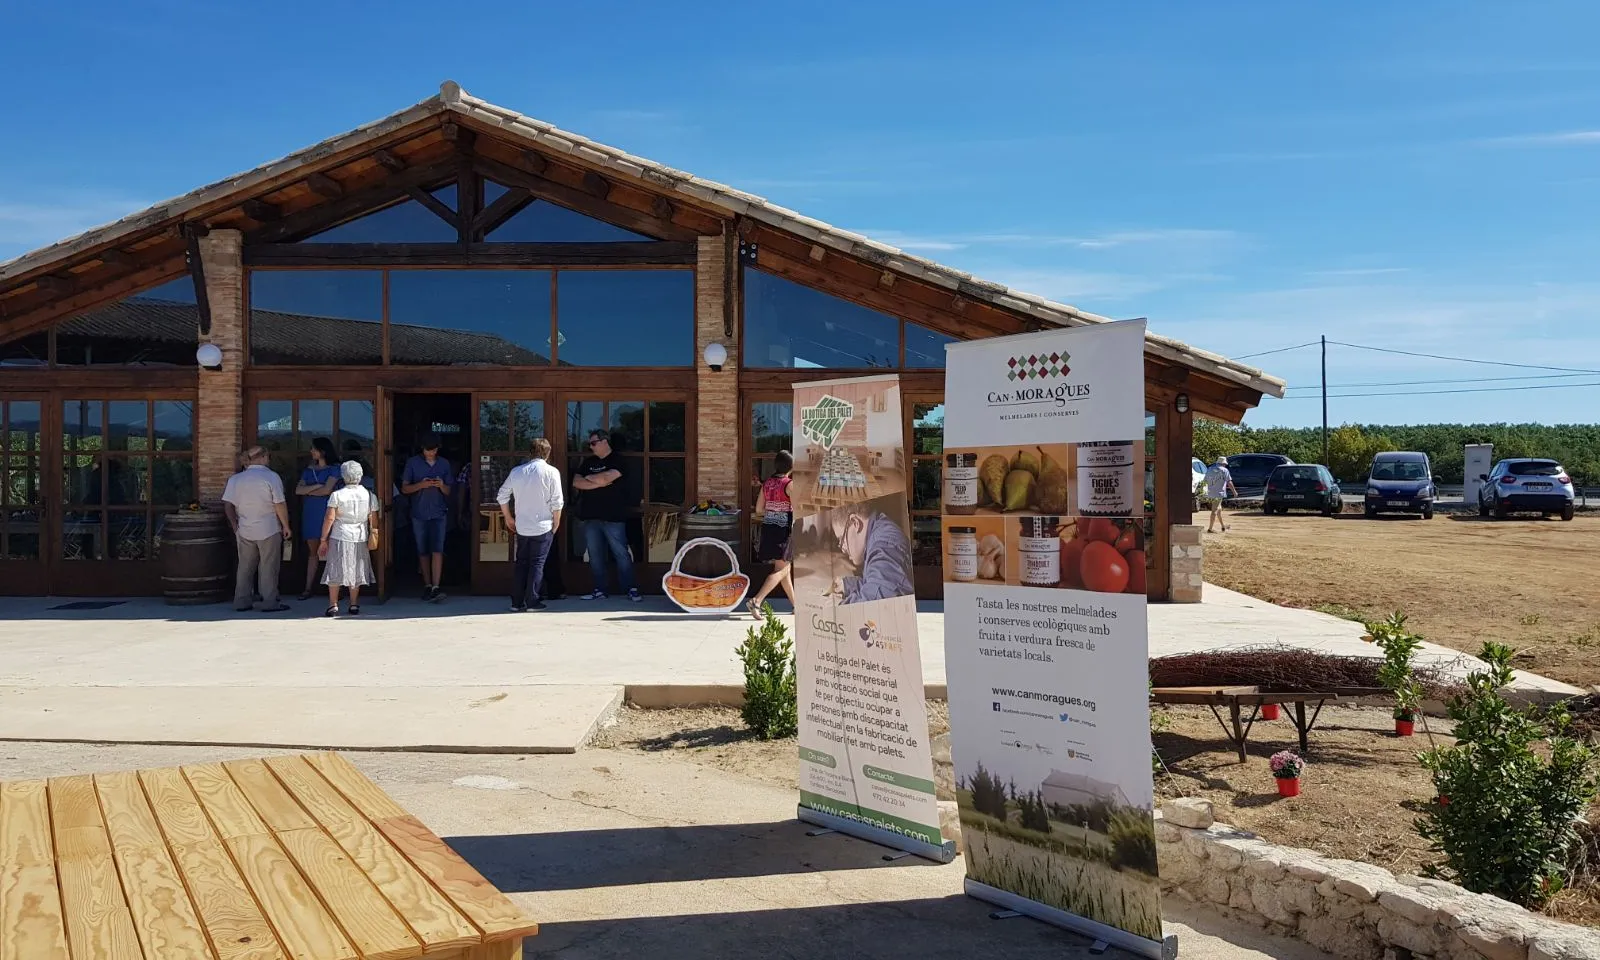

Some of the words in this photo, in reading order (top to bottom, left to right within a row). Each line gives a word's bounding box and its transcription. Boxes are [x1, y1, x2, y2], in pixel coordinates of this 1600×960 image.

[802, 410, 807, 419] LA
[809, 408, 826, 419] BOTIGA
[828, 408, 836, 418] DEL
[837, 407, 852, 417] PALET
[1092, 479, 1119, 487] FIGUES
[976, 597, 1004, 610] Tasta
[1006, 598, 1019, 611] les
[1022, 602, 1058, 613] nostres
[1061, 605, 1117, 619] melmelades
[812, 614, 845, 635] Casas
[978, 613, 982, 624] i
[984, 617, 1030, 628] conserves
[1033, 618, 1087, 634] ecològiques
[1089, 624, 1110, 635] amb
[978, 630, 1005, 642] fruita
[1008, 632, 1011, 642] i
[1014, 633, 1052, 646] verdura
[1056, 636, 1084, 649] fresca
[1085, 640, 1096, 652] de
[817, 650, 825, 660] La
[826, 652, 847, 668] Botiga
[849, 657, 859, 668] del
[862, 658, 880, 673] Palet
[882, 665, 891, 674] és
[979, 646, 1022, 659] varietats
[1024, 649, 1054, 663] locals.
[824, 666, 851, 680] projecte
[853, 672, 897, 689] empresarial
[816, 677, 829, 688] amb
[830, 680, 857, 694] vocació
[860, 686, 880, 698] social
[883, 693, 898, 703] que
[992, 687, 1096, 711] www.canmoragues.org
[815, 689, 821, 698] té
[822, 693, 833, 702] per
[835, 694, 864, 708] objectiu
[866, 703, 893, 716] ocupar
[811, 702, 840, 717] persones
[842, 709, 858, 721] amb
[860, 711, 908, 732] discapacitat
[817, 728, 846, 744] mobiliari
[846, 734, 858, 747] fet
[859, 739, 877, 751] amb
[878, 744, 905, 759] palets.
[846, 723, 856, 733] en
[857, 724, 863, 735] la
[865, 725, 904, 744] fabricació
[906, 736, 917, 748] de
